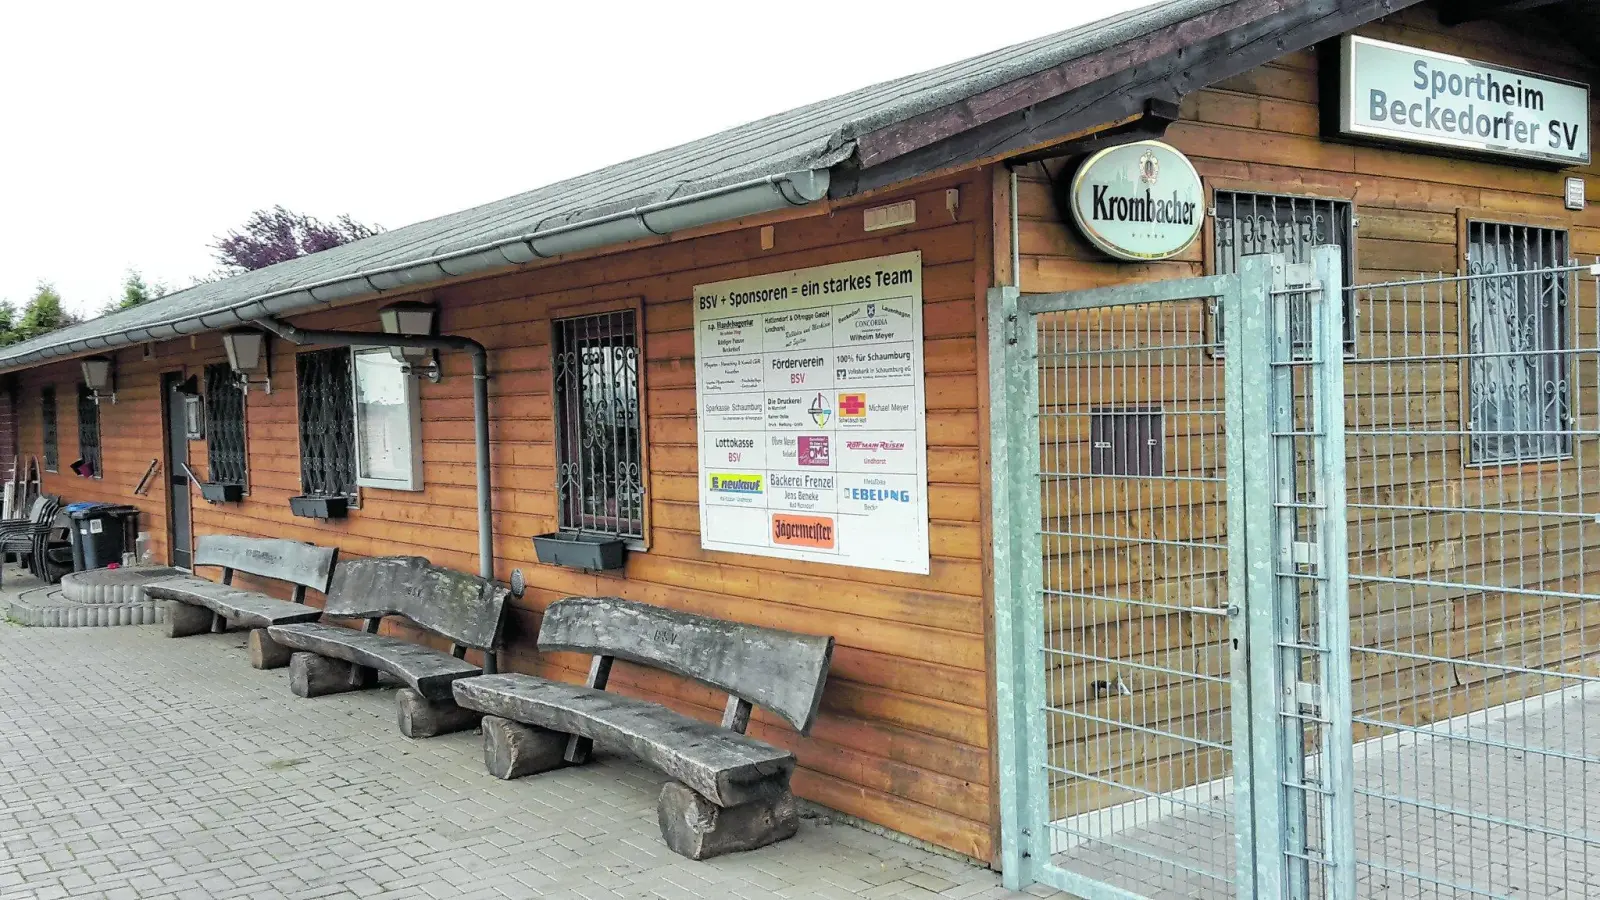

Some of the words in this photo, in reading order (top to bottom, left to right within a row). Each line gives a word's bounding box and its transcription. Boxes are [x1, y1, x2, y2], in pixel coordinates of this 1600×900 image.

[1413, 59, 1544, 111] Sportheim
[1369, 88, 1540, 144] Beckedorfer
[1548, 119, 1579, 151] SV
[1092, 184, 1196, 226] Krombacher
[700, 294, 718, 310] BSV
[729, 284, 788, 308] Sponsoren
[802, 282, 820, 297] ein
[824, 274, 872, 294] starkes
[875, 268, 913, 287] Team
[855, 318, 888, 328] CONCORDIA
[850, 333, 874, 341] Wilhelm
[772, 356, 824, 370] Förderverein
[836, 354, 854, 364] 100%
[855, 354, 866, 362] für
[867, 351, 911, 361] Schaumburg
[790, 373, 806, 384] BSV
[777, 396, 802, 404] Druckerei
[706, 404, 730, 413] Sparkasse
[732, 403, 762, 412] Schaumburg
[868, 404, 890, 412] Michael
[890, 404, 909, 412] Meyer
[716, 438, 754, 448] Lottokasse
[728, 452, 741, 462] BSV
[722, 479, 760, 490] neukauf
[770, 474, 803, 487] Bäckerei
[804, 475, 834, 488] Frenzel
[784, 490, 796, 500] Jens
[798, 491, 819, 501] Beneke
[852, 488, 910, 502] EBELING
